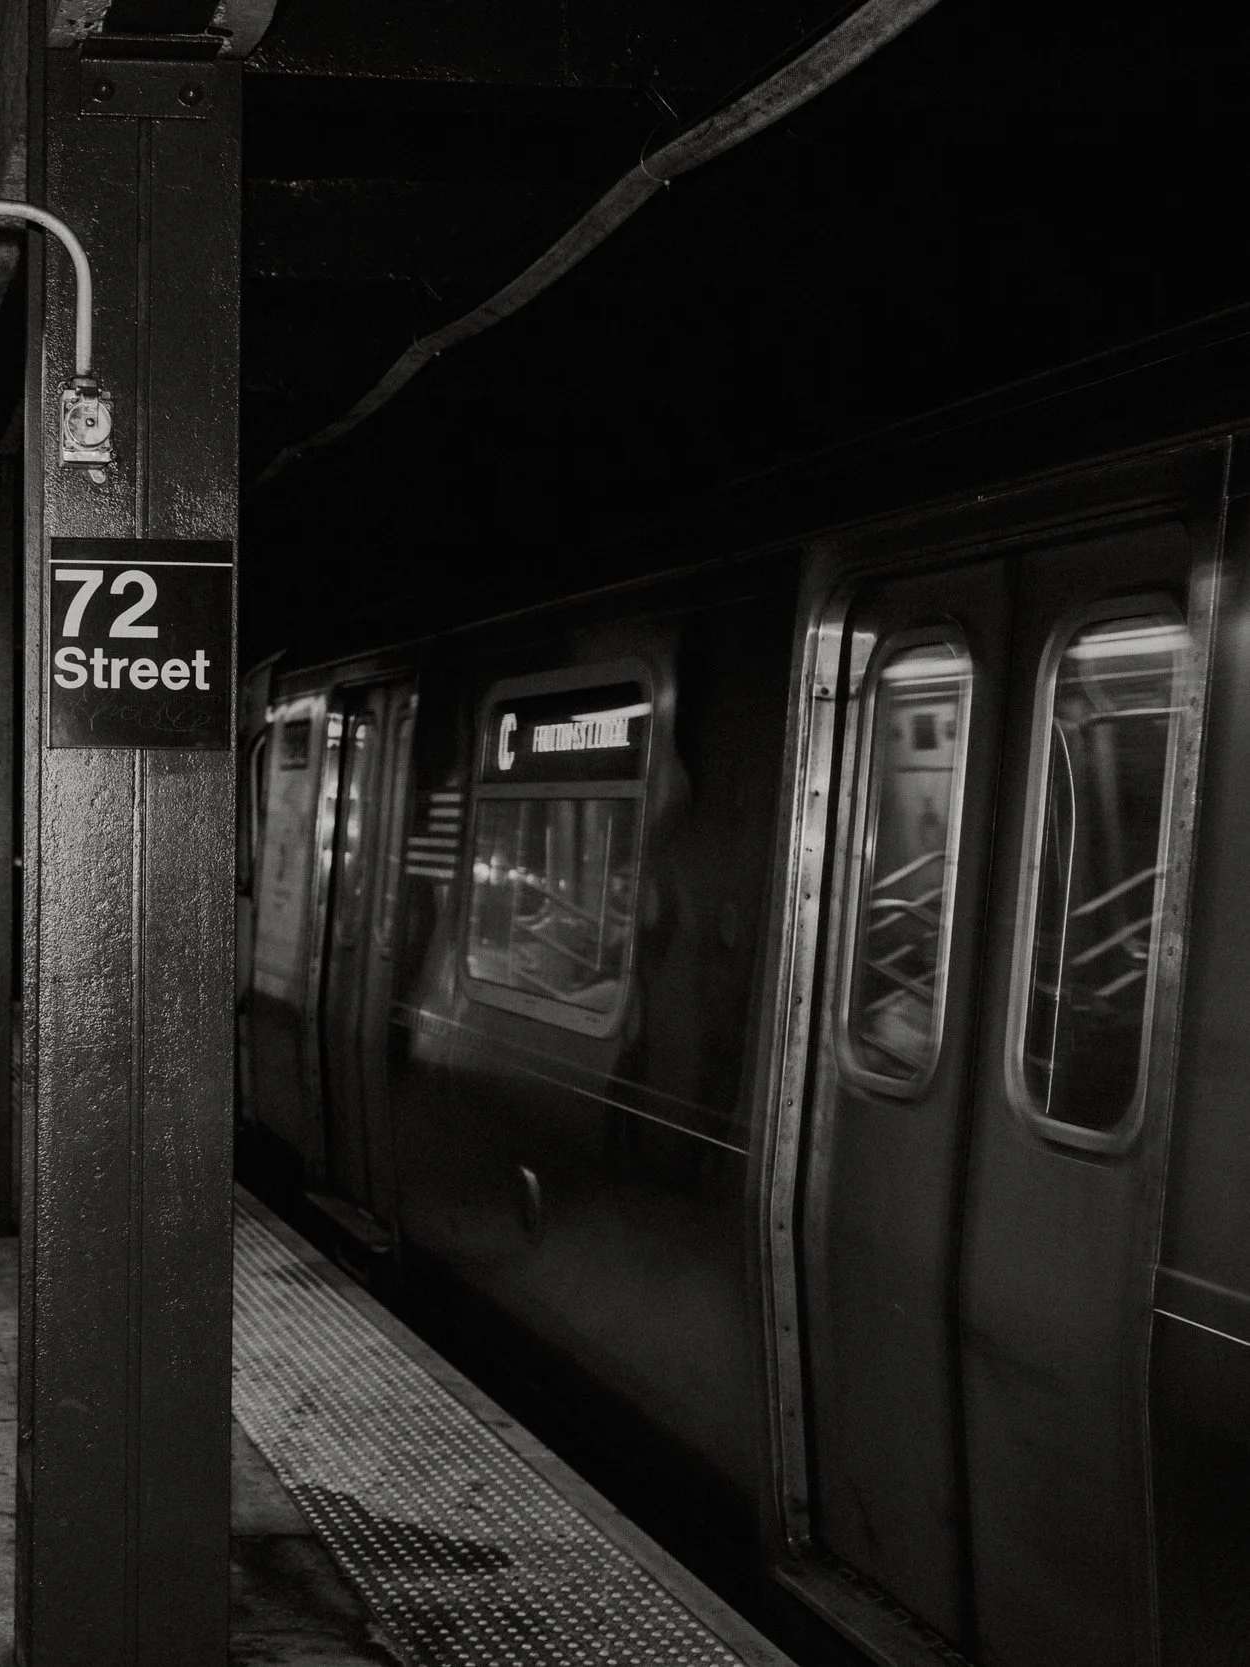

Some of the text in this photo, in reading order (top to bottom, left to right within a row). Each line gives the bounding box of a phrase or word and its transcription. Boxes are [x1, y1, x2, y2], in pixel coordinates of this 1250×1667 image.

[55, 569, 159, 639] 72
[53, 646, 210, 691] Street
[498, 713, 517, 771] C
